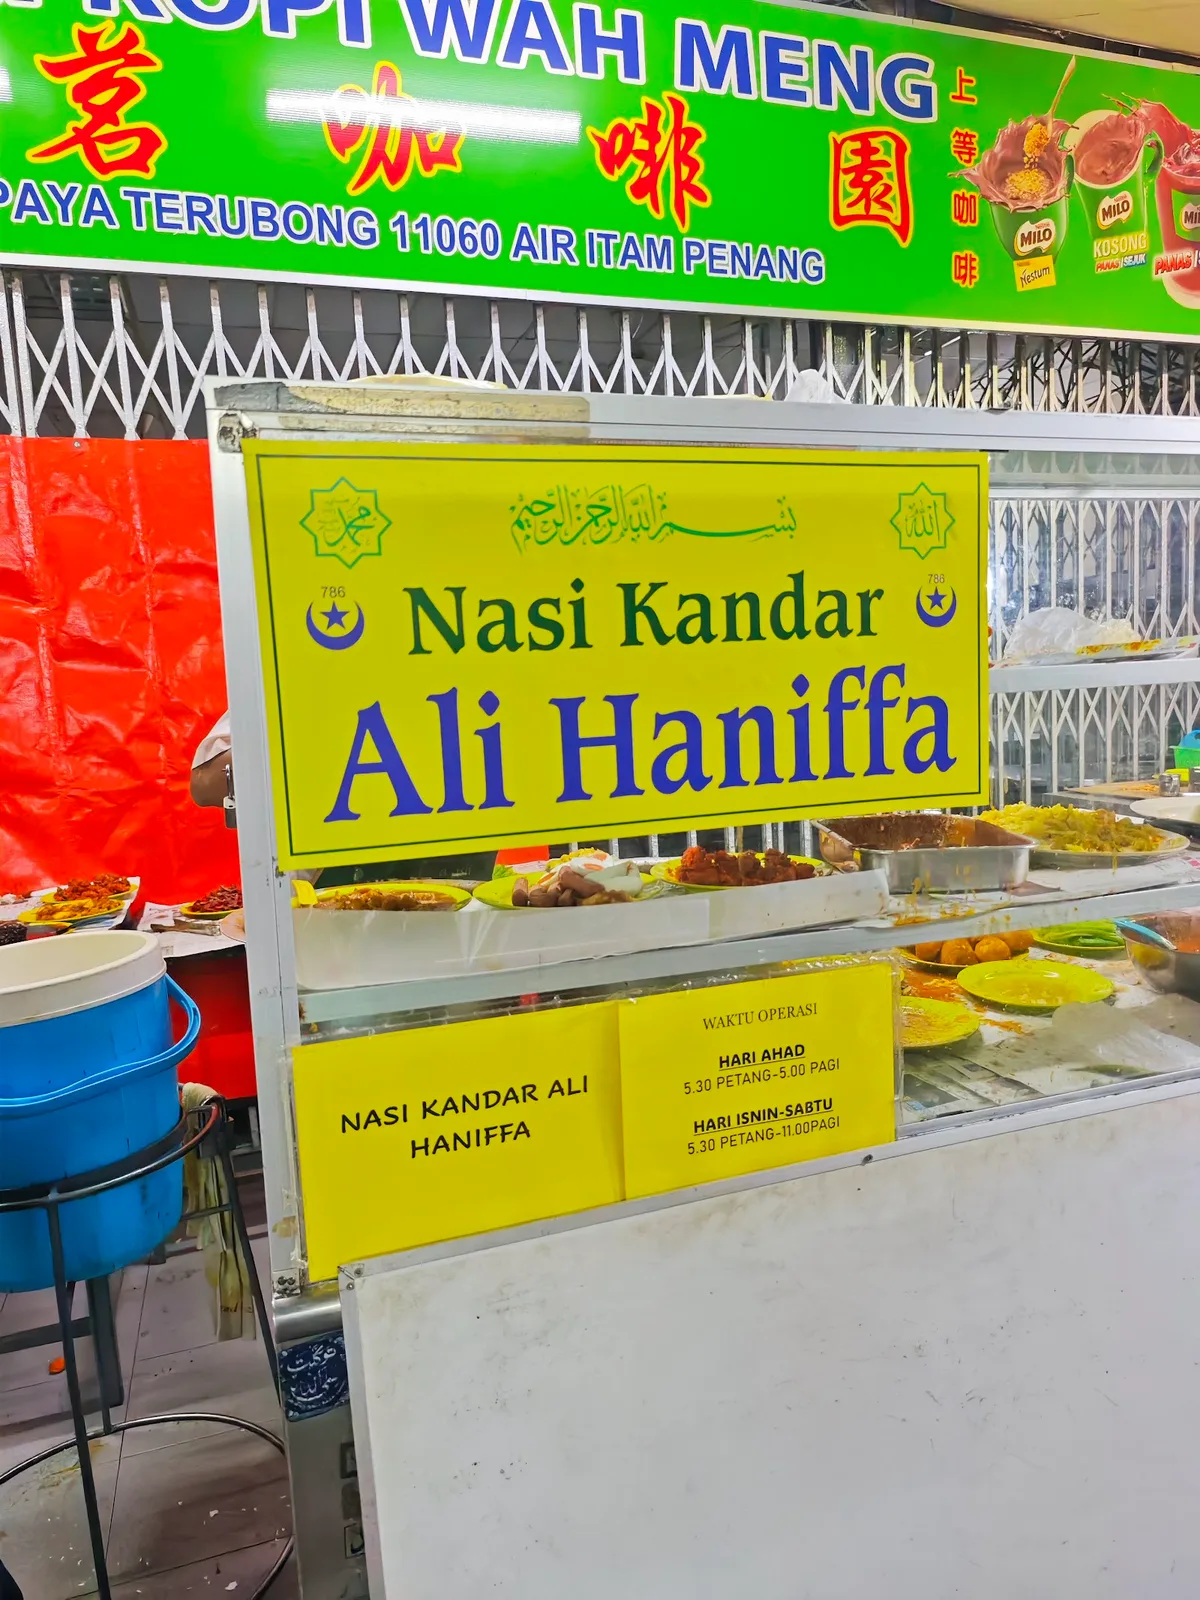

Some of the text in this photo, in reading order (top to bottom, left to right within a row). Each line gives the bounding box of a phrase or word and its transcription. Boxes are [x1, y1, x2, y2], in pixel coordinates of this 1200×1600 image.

[400, 0, 646, 84] WAH
[675, 18, 937, 122] MENG
[950, 66, 978, 287] 上等咖啡
[1102, 200, 1130, 221] MILO
[119, 186, 379, 250] TERUBONG
[390, 211, 501, 259] 11060
[510, 222, 580, 266] AIR
[585, 229, 673, 274] ITAM
[684, 239, 825, 284] PENANG
[1020, 228, 1052, 247] MILO
[1094, 233, 1147, 258] KOSONG
[1020, 267, 1050, 288] Nestum
[321, 586, 346, 598] 786
[928, 574, 945, 584] 786
[403, 570, 884, 655] Nasi Kandar
[323, 663, 957, 823] Ali Haniffa
[703, 1003, 818, 1030] WAKTU OPERASI
[719, 1044, 806, 1068] HARI AHAD
[684, 1058, 840, 1095] 5.30 PETANG-5.00 PAGI
[341, 1075, 589, 1133] NASI KANDAR ALI
[694, 1098, 833, 1133] HARI ISNIN-SABTU
[411, 1121, 531, 1158] HANIFFA
[688, 1116, 840, 1155] 5.30 PETANG-11.00PAGI
